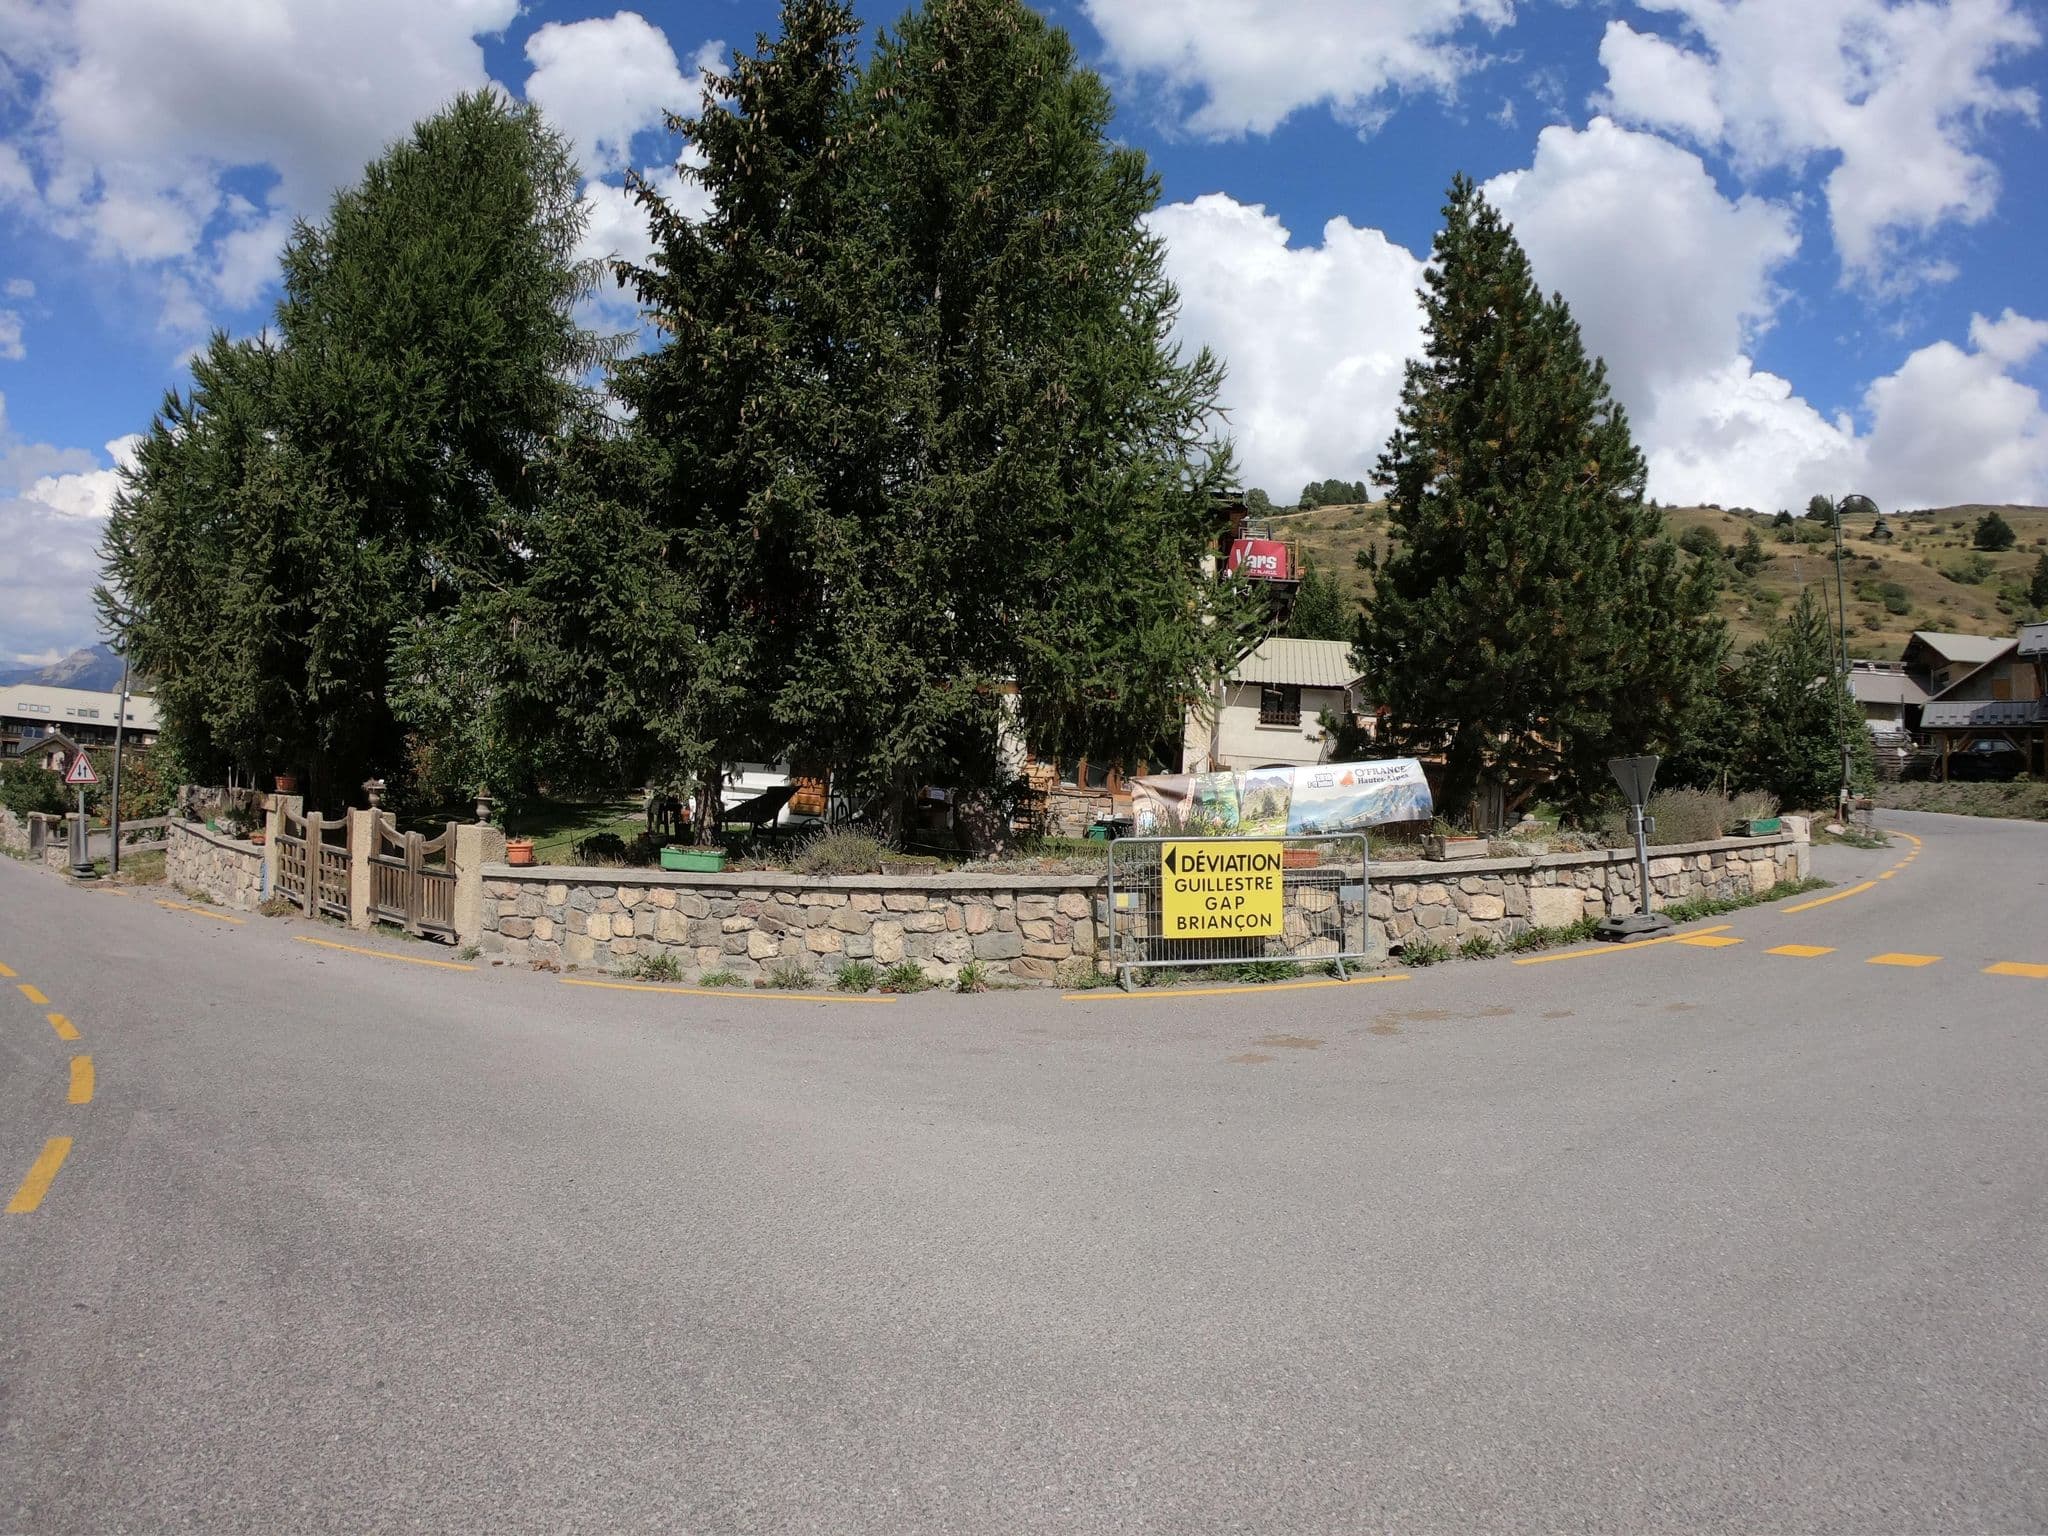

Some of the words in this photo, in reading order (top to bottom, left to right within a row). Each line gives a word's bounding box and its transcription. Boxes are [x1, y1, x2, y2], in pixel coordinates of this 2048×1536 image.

[1236, 541, 1277, 569] Vars
[1181, 850, 1280, 872] DÉVIATION
[1174, 876, 1273, 892] GUILLESTRE
[1205, 896, 1245, 911] GAP
[1177, 913, 1272, 932] BRIANÇON
